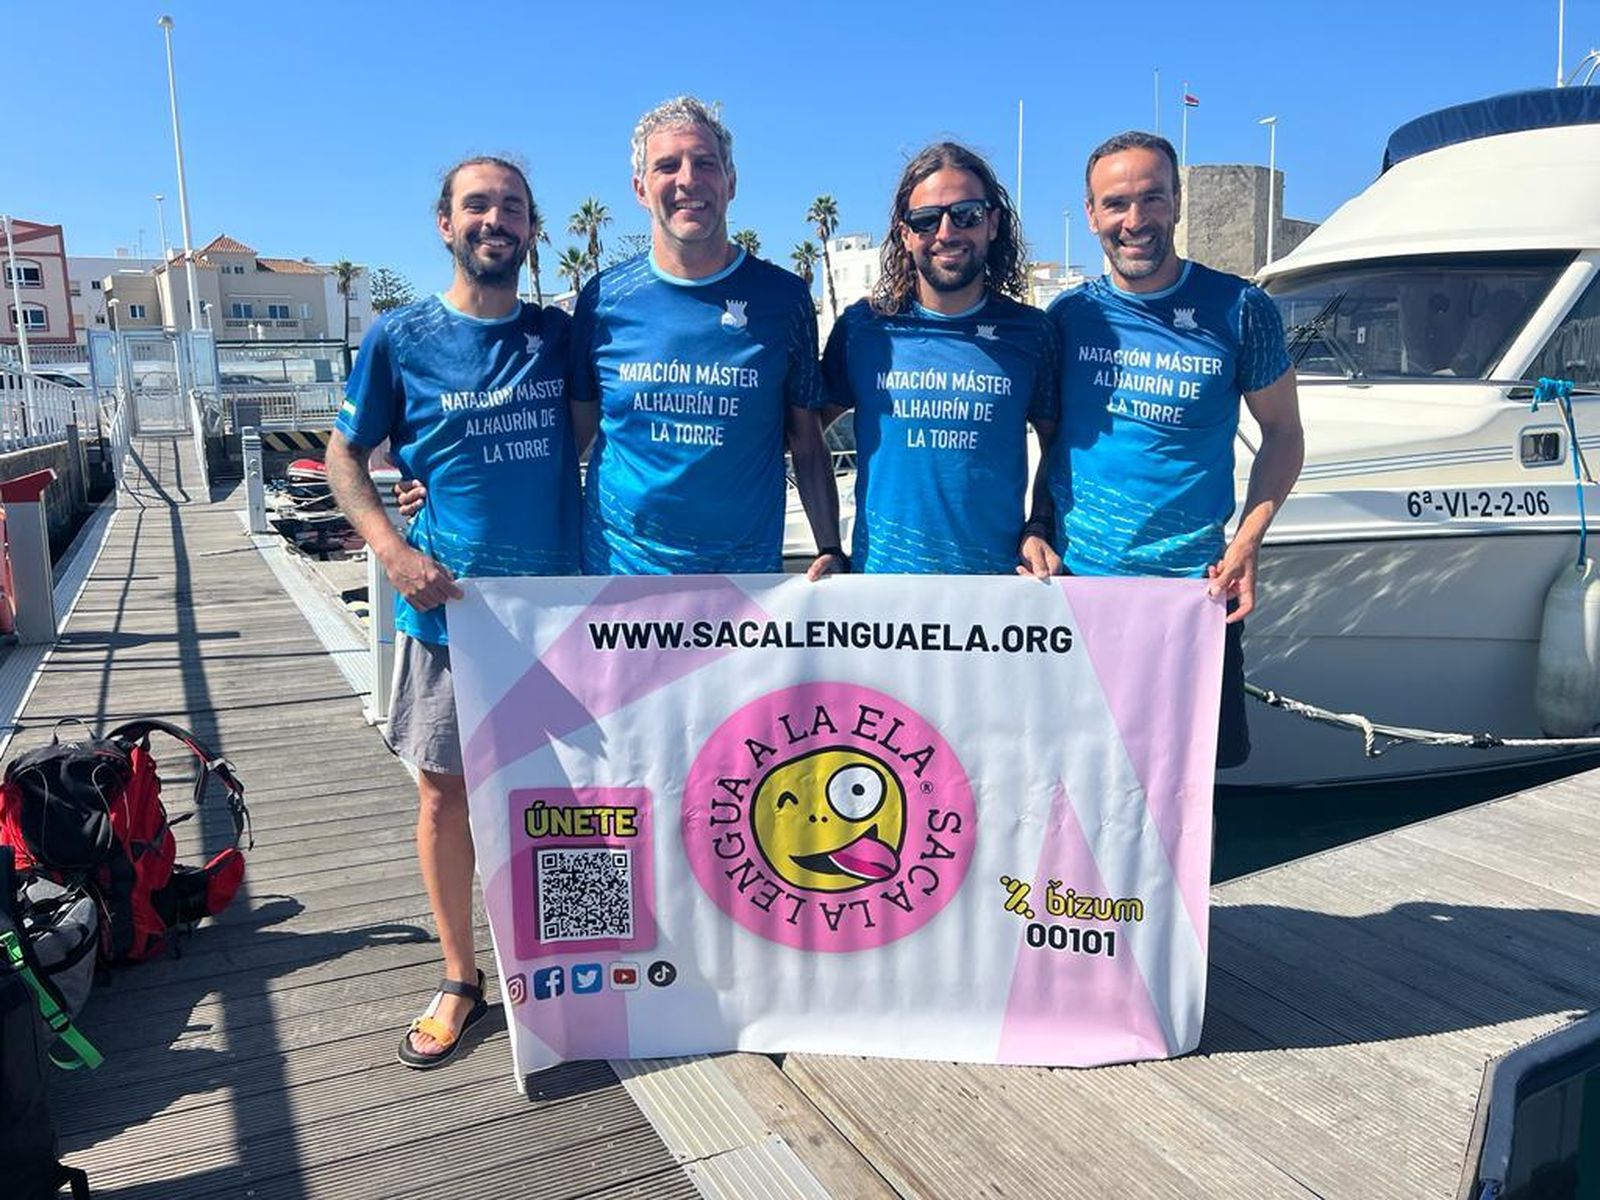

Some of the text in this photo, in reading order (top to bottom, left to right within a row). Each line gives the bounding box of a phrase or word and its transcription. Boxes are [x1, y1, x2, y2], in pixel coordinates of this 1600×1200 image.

[618, 359, 759, 388] NATACIÓN MÁSTER
[1079, 346, 1223, 376] NATACIÓN MÁSTER
[876, 368, 1012, 396] NATACIÓN MÁSTER
[1093, 369, 1201, 400] ALHAURÍN DE
[440, 387, 513, 412] NATACIÓN
[633, 390, 739, 417] ALHAURÍN DE
[892, 397, 994, 422] ALHAURÍN DE
[1106, 396, 1185, 424] LA TORRE
[465, 407, 556, 437] ALHAURÍN DE
[651, 422, 725, 446] LA TORRE
[483, 438, 550, 463] LA TORRE
[907, 428, 979, 449] LA TORRE
[1407, 490, 1550, 518] 6ª-VI-2-2-06
[589, 620, 1073, 654] WWW.SACALENGUAELA.ORG
[778, 704, 838, 745] LA
[744, 738, 777, 769] A
[851, 704, 936, 778] ELA
[525, 800, 638, 838] ÚNETE
[710, 776, 807, 925] LENGUA
[881, 808, 962, 913] SACA
[820, 900, 875, 931] LA
[1045, 880, 1144, 922] bizum
[1026, 923, 1116, 957] 00101
